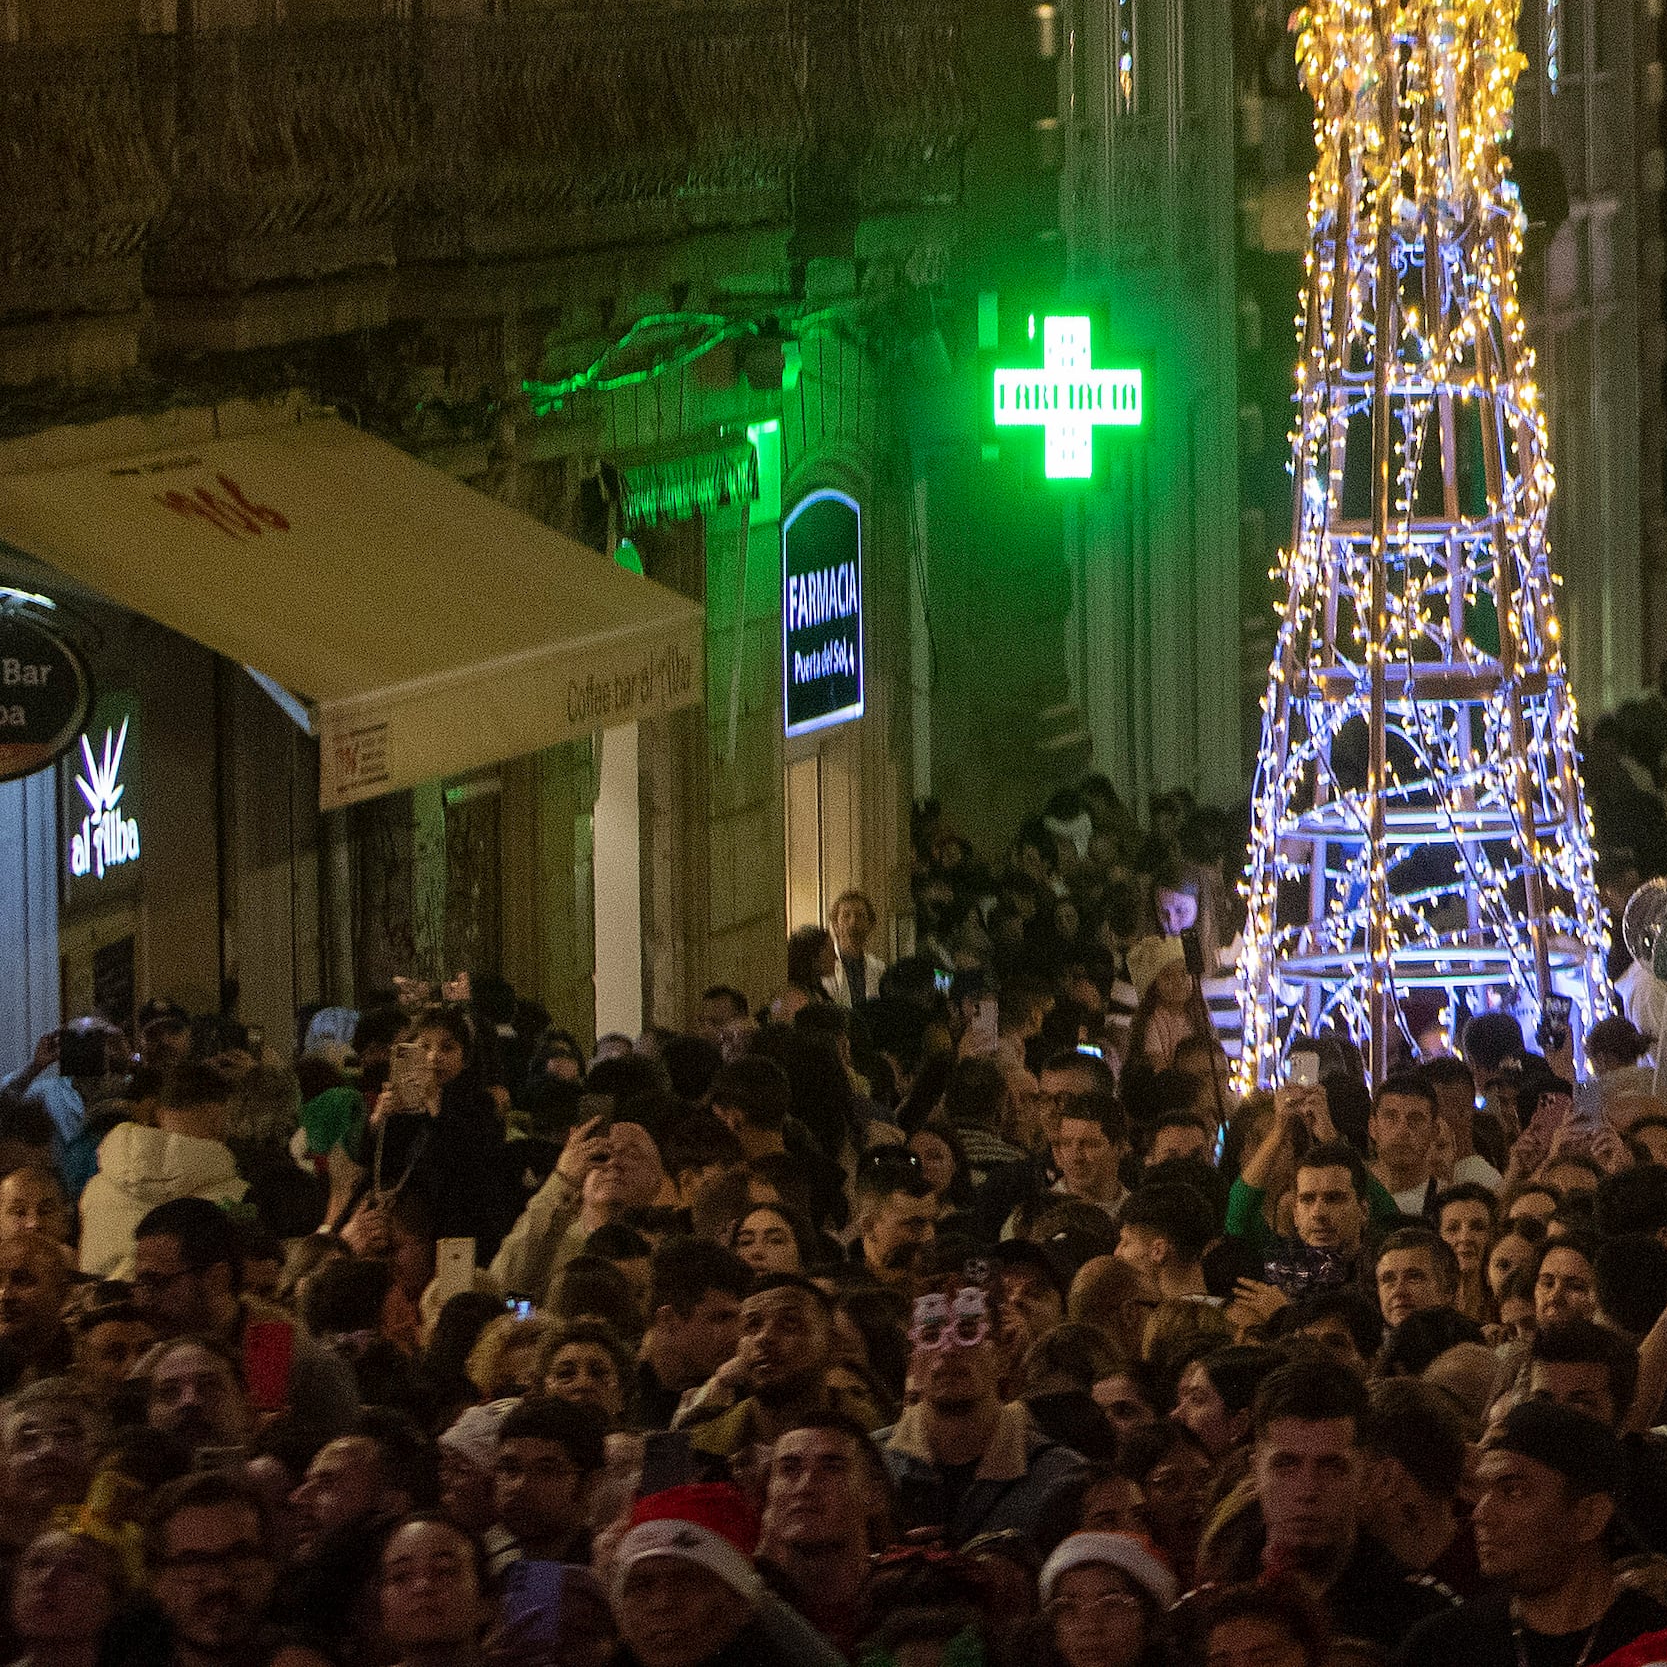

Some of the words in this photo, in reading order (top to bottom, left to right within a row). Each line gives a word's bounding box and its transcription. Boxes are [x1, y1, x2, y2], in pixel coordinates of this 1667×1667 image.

[789, 560, 858, 632] FARMACIA
[2, 658, 53, 686] Bar
[795, 649, 820, 685] Puerta
[821, 638, 833, 677] del
[72, 816, 90, 877] al
